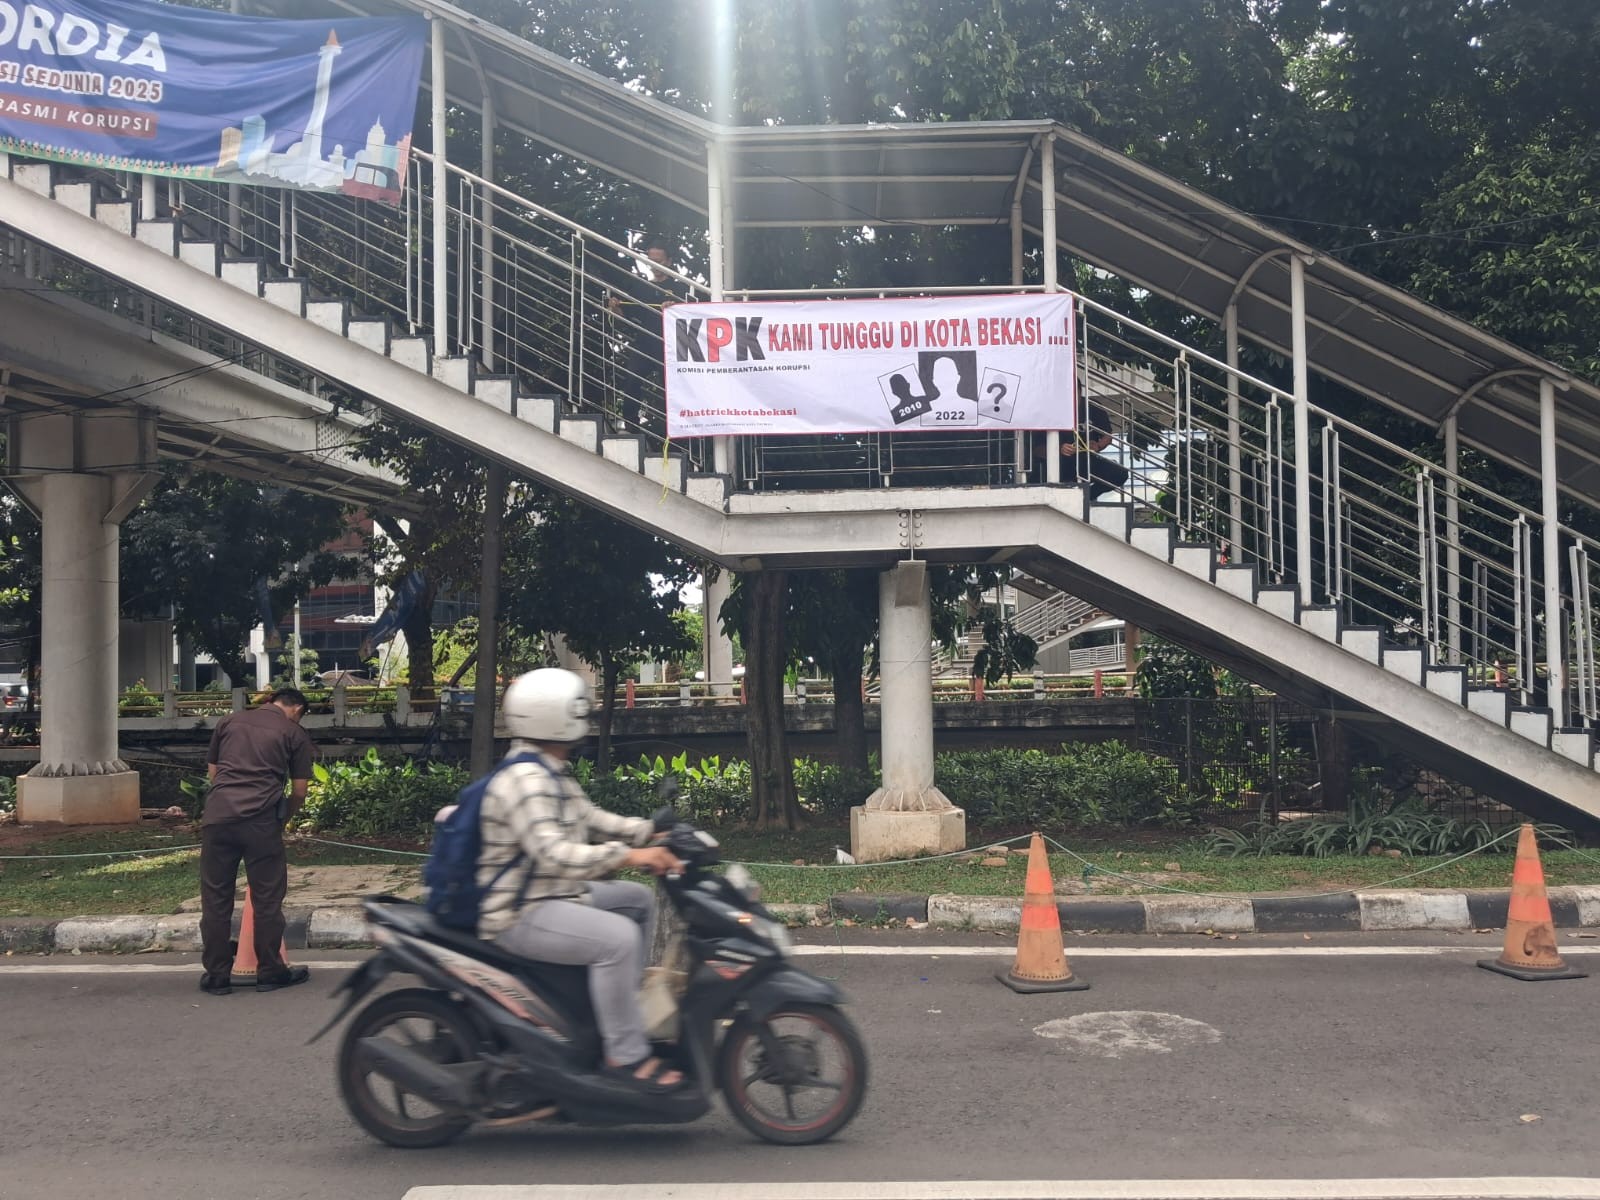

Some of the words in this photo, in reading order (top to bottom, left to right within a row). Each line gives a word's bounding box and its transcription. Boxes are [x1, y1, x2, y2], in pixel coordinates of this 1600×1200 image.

[22, 64, 104, 95] SEDUNIA
[108, 76, 162, 102] 2025
[67, 110, 150, 131] KORUPSI
[676, 317, 766, 362] KPK
[768, 324, 813, 352] KAMI
[818, 321, 894, 351] TUNGGU
[900, 321, 919, 348] DI
[925, 319, 972, 347] KOTA
[977, 317, 1042, 346] BEKASI
[706, 365, 774, 374] PEMBERANTASAN
[986, 382, 1008, 413] ?
[898, 401, 922, 417] 2010
[935, 411, 965, 421] 2022
